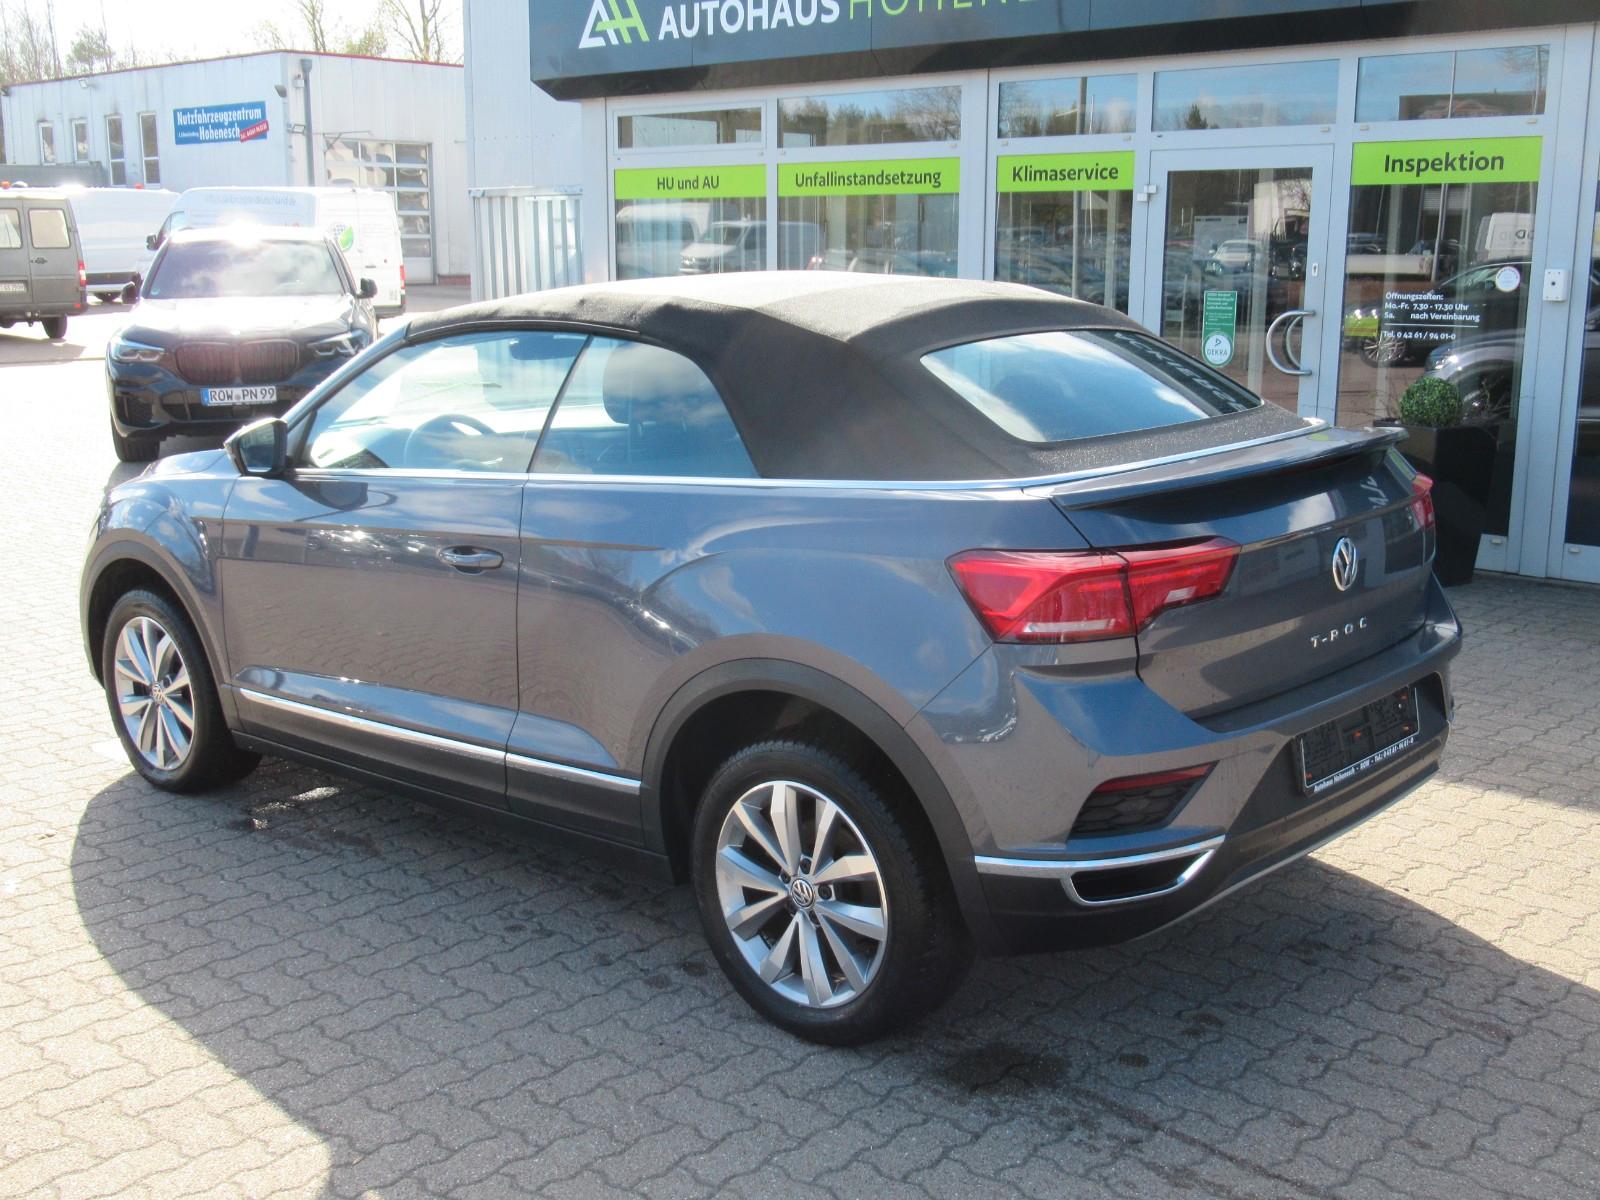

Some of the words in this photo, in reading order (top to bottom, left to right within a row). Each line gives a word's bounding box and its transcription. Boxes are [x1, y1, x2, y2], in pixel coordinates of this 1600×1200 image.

[658, 0, 840, 40] AUTOHAUS
[177, 107, 262, 126] Nutzfahrzeugzentrum
[199, 123, 240, 140] Hohenesch
[1012, 163, 1119, 182] Klimaservice
[1384, 151, 1505, 178] Inspektion
[657, 177, 674, 190] HU
[678, 175, 699, 190] und
[702, 175, 720, 189] AU
[795, 169, 942, 188] Unfallinstandsetzung
[1384, 302, 1410, 310] Mo.-Fr.
[1413, 303, 1428, 311] 7.30
[1434, 303, 1453, 311] 17.30
[1454, 303, 1469, 311] Uhr
[1384, 311, 1395, 319] Sa.
[1410, 312, 1429, 320] nach
[1430, 312, 1480, 323] Vereinbarung
[1403, 331, 1412, 339] 42
[1429, 332, 1439, 340] 94
[210, 389, 233, 402] ROW
[242, 388, 258, 401] PN
[260, 387, 275, 400] 99
